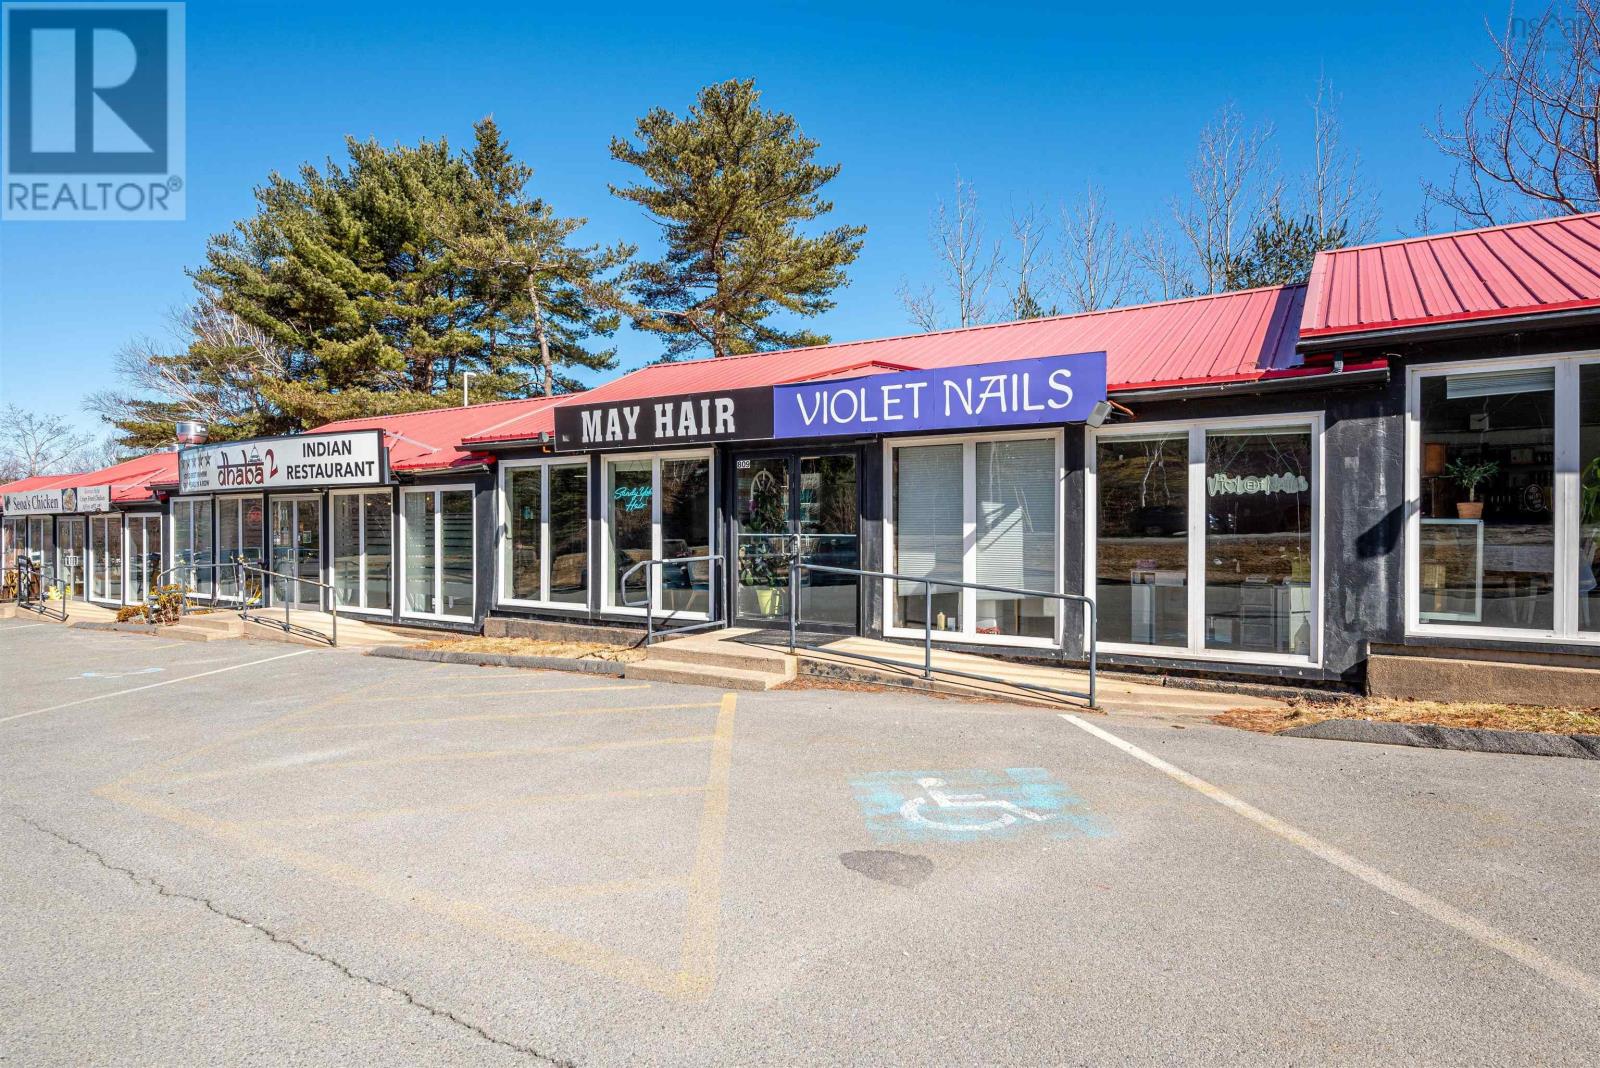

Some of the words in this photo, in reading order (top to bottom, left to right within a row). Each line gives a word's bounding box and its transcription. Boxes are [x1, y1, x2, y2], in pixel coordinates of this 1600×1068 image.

[797, 381, 927, 426] VIOLET
[943, 368, 1074, 418] NAILS
[581, 405, 640, 443] MAY
[654, 397, 736, 438] HAIR
[302, 439, 352, 458] INDIAN
[217, 450, 264, 486] dhaba
[264, 448, 279, 479] 2
[286, 460, 375, 480] RESTAURANT
[737, 460, 750, 468] 809
[31, 493, 59, 510] Chicken
